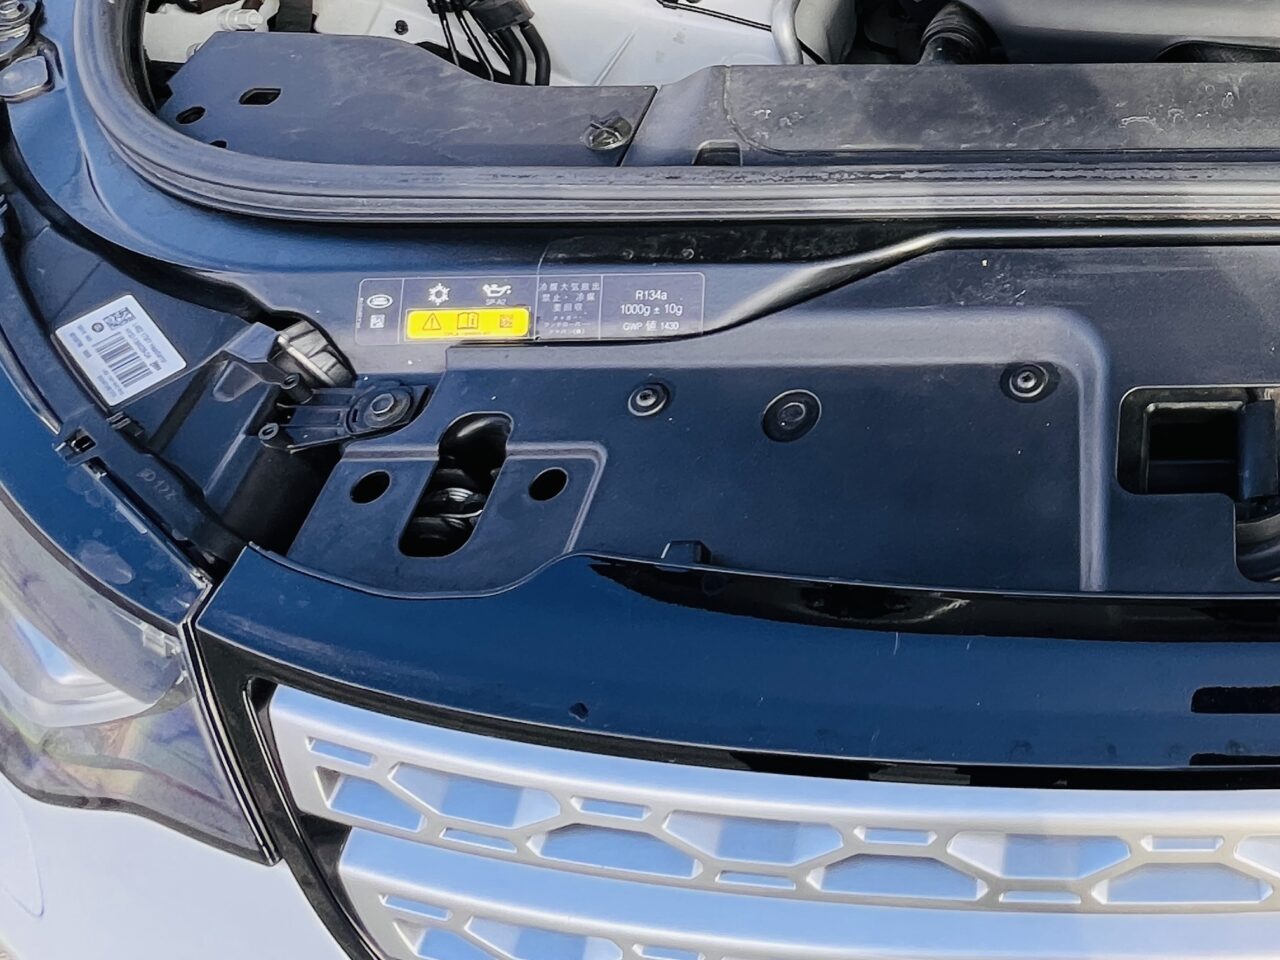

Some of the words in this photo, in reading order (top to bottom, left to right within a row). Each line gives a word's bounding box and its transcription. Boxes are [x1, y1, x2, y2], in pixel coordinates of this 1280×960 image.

[635, 289, 668, 300] R134a
[620, 303, 651, 316] 1000g
[664, 303, 683, 316] 10g
[622, 321, 643, 331] GWP
[660, 321, 680, 331] 1430
